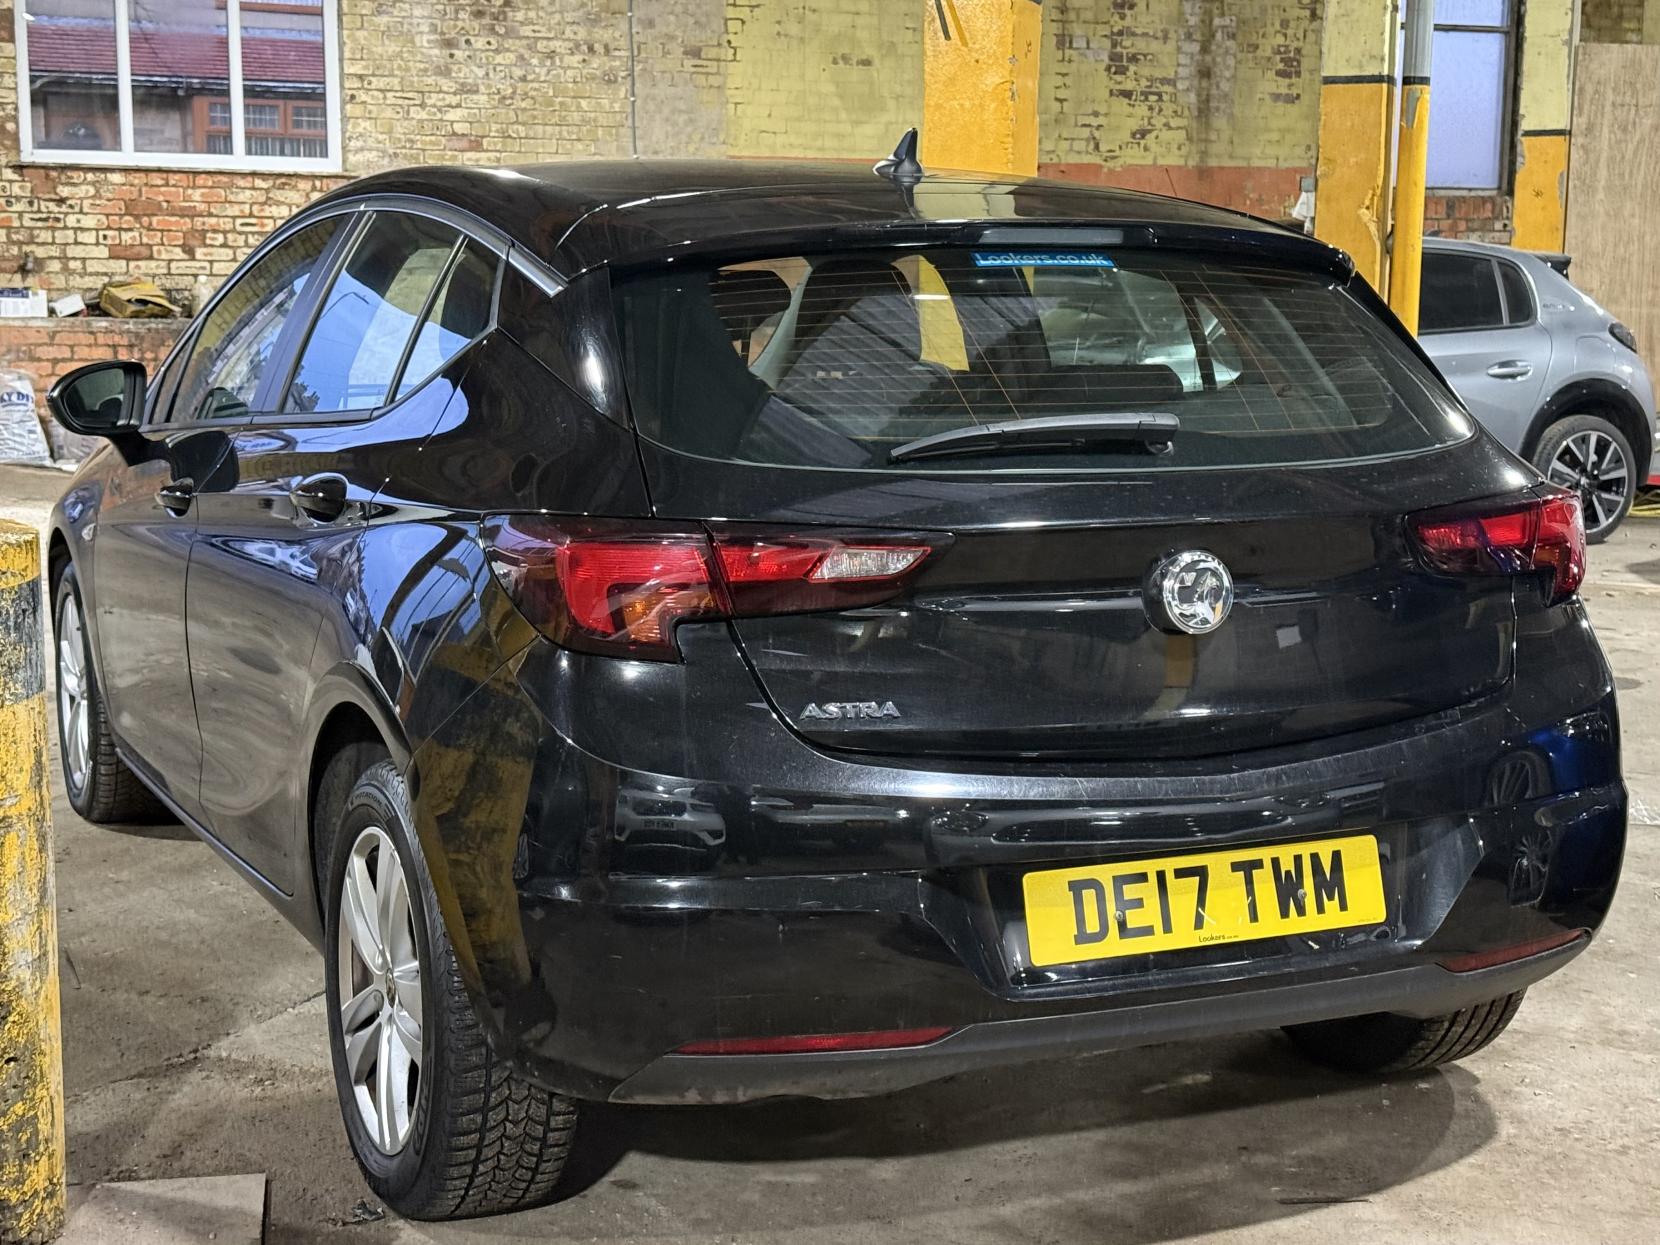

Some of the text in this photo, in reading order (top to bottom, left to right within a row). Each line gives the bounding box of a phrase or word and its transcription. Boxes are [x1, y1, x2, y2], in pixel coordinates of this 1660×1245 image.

[974, 252, 1109, 265] Lookers.co.uk
[800, 701, 901, 720] ASTRA
[1067, 849, 1349, 946] DE17 TWM
